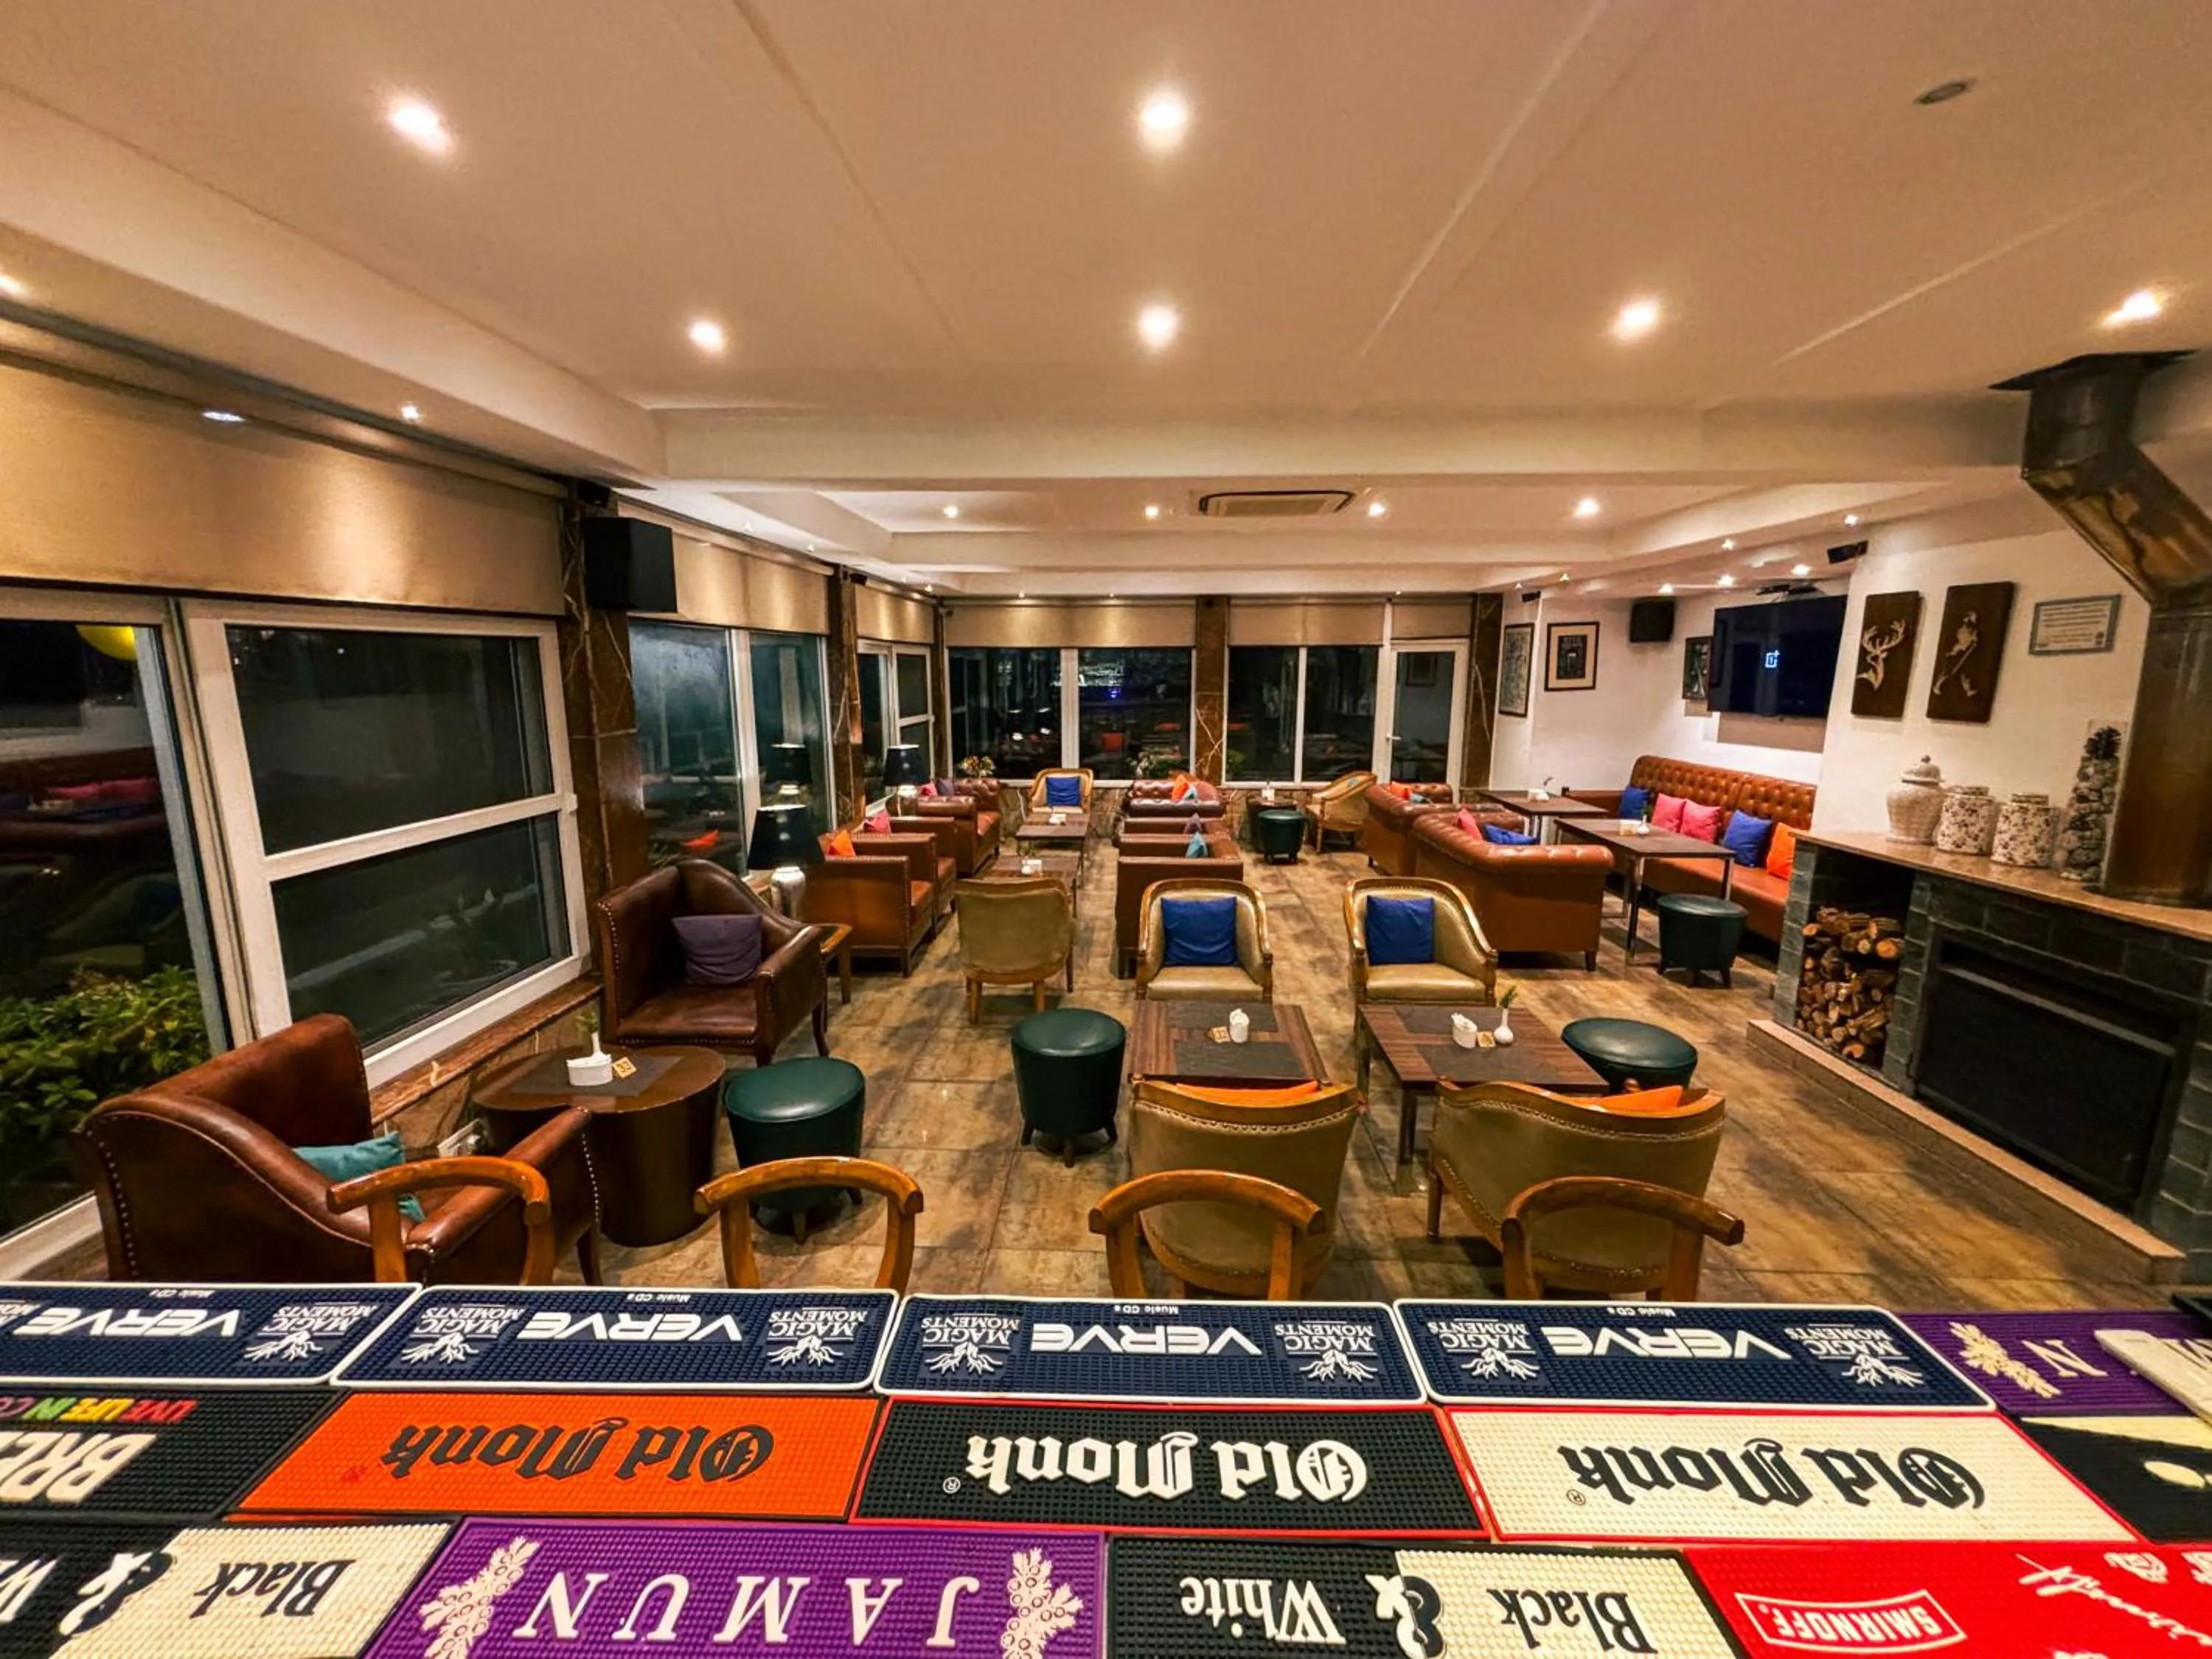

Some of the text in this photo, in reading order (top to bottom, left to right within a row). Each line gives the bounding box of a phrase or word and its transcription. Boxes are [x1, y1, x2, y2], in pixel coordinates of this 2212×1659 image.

[656, 1293, 691, 1303] Music
[272, 1305, 377, 1316] MOMENTS
[423, 1306, 524, 1318] MOMENTS
[769, 1310, 868, 1321] MOMENTS
[1144, 1305, 1179, 1315] Music
[14, 1308, 240, 1336] VERVE
[264, 1318, 359, 1333] MAGIC
[413, 1318, 507, 1334] MAGIC
[518, 1312, 742, 1340] VERVE
[768, 1321, 856, 1338] MAGIC
[921, 1316, 1020, 1329] MOMENTS
[1274, 1323, 1374, 1336] MOMENTS
[1427, 1321, 1526, 1335] MOMENTS
[922, 1328, 1011, 1344] MAGIC
[1031, 1324, 1262, 1354] VERVE
[1784, 1326, 1892, 1339] MOMENTS
[1284, 1335, 1373, 1351] MAGIC
[1439, 1334, 1528, 1349] MAGIC
[1540, 1326, 1792, 1360] VERVE
[1803, 1338, 1900, 1355] MAGIC
[380, 1417, 774, 1483] Old Monk
[966, 1431, 1367, 1503] Old Monk
[1557, 1438, 1986, 1509] Old Monk
[189, 1558, 358, 1618] Black
[512, 1571, 980, 1649] JAMUN
[1180, 1575, 1346, 1644] White
[1487, 1587, 1658, 1655] Black
[1772, 1605, 1944, 1644] SMIRNOFF
